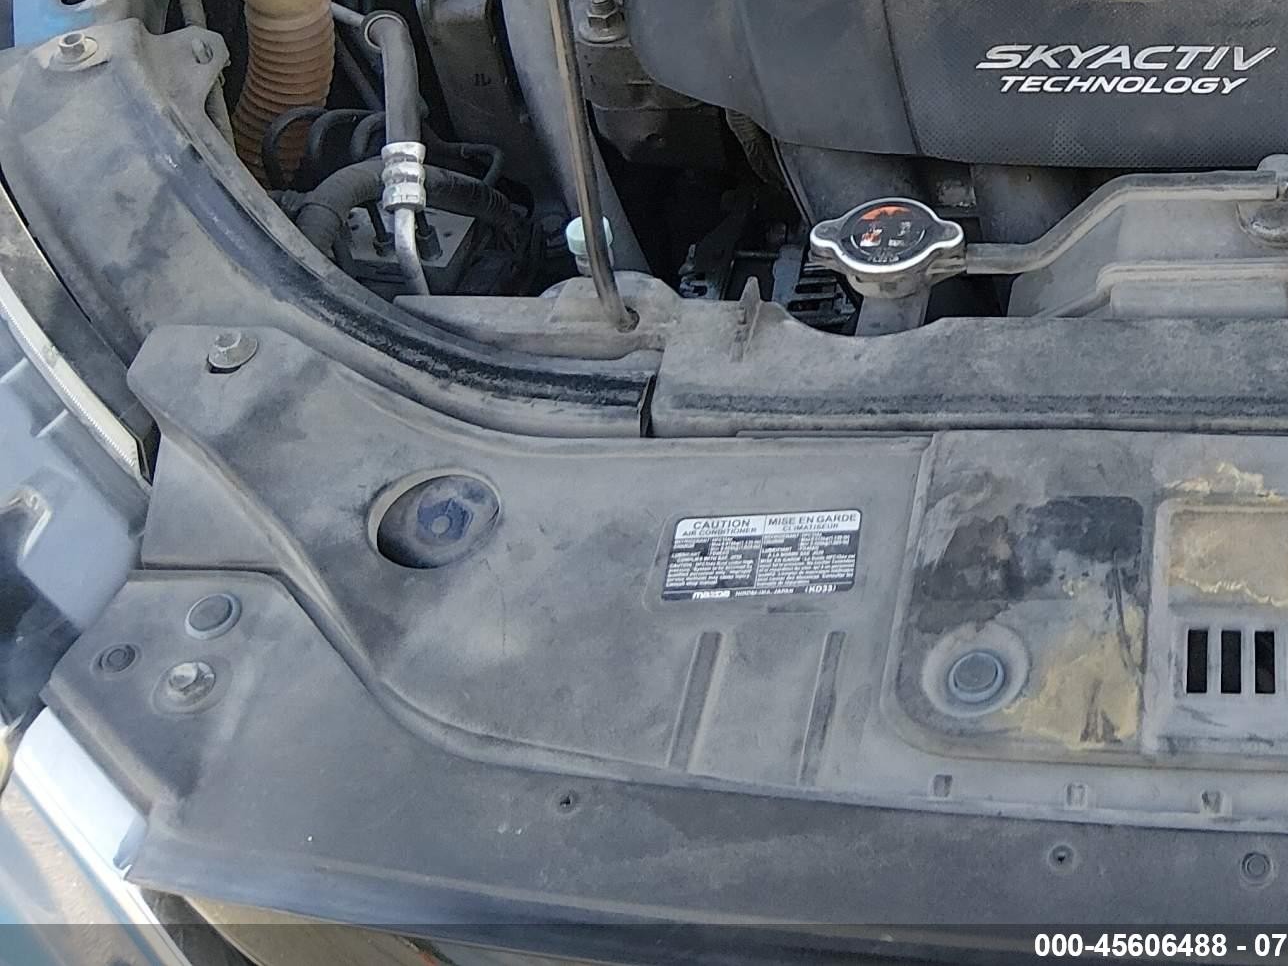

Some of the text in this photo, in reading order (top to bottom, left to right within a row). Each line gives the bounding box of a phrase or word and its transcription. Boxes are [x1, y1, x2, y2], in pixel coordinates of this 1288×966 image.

[976, 45, 1277, 71] SKYACTIV
[1000, 75, 1249, 94] TECHNOLOGY
[693, 518, 751, 530] CAUTION
[768, 513, 857, 526] MISE EN GARDE
[699, 527, 757, 536] CONDITIONER
[782, 523, 839, 532] CLIMATISEUR
